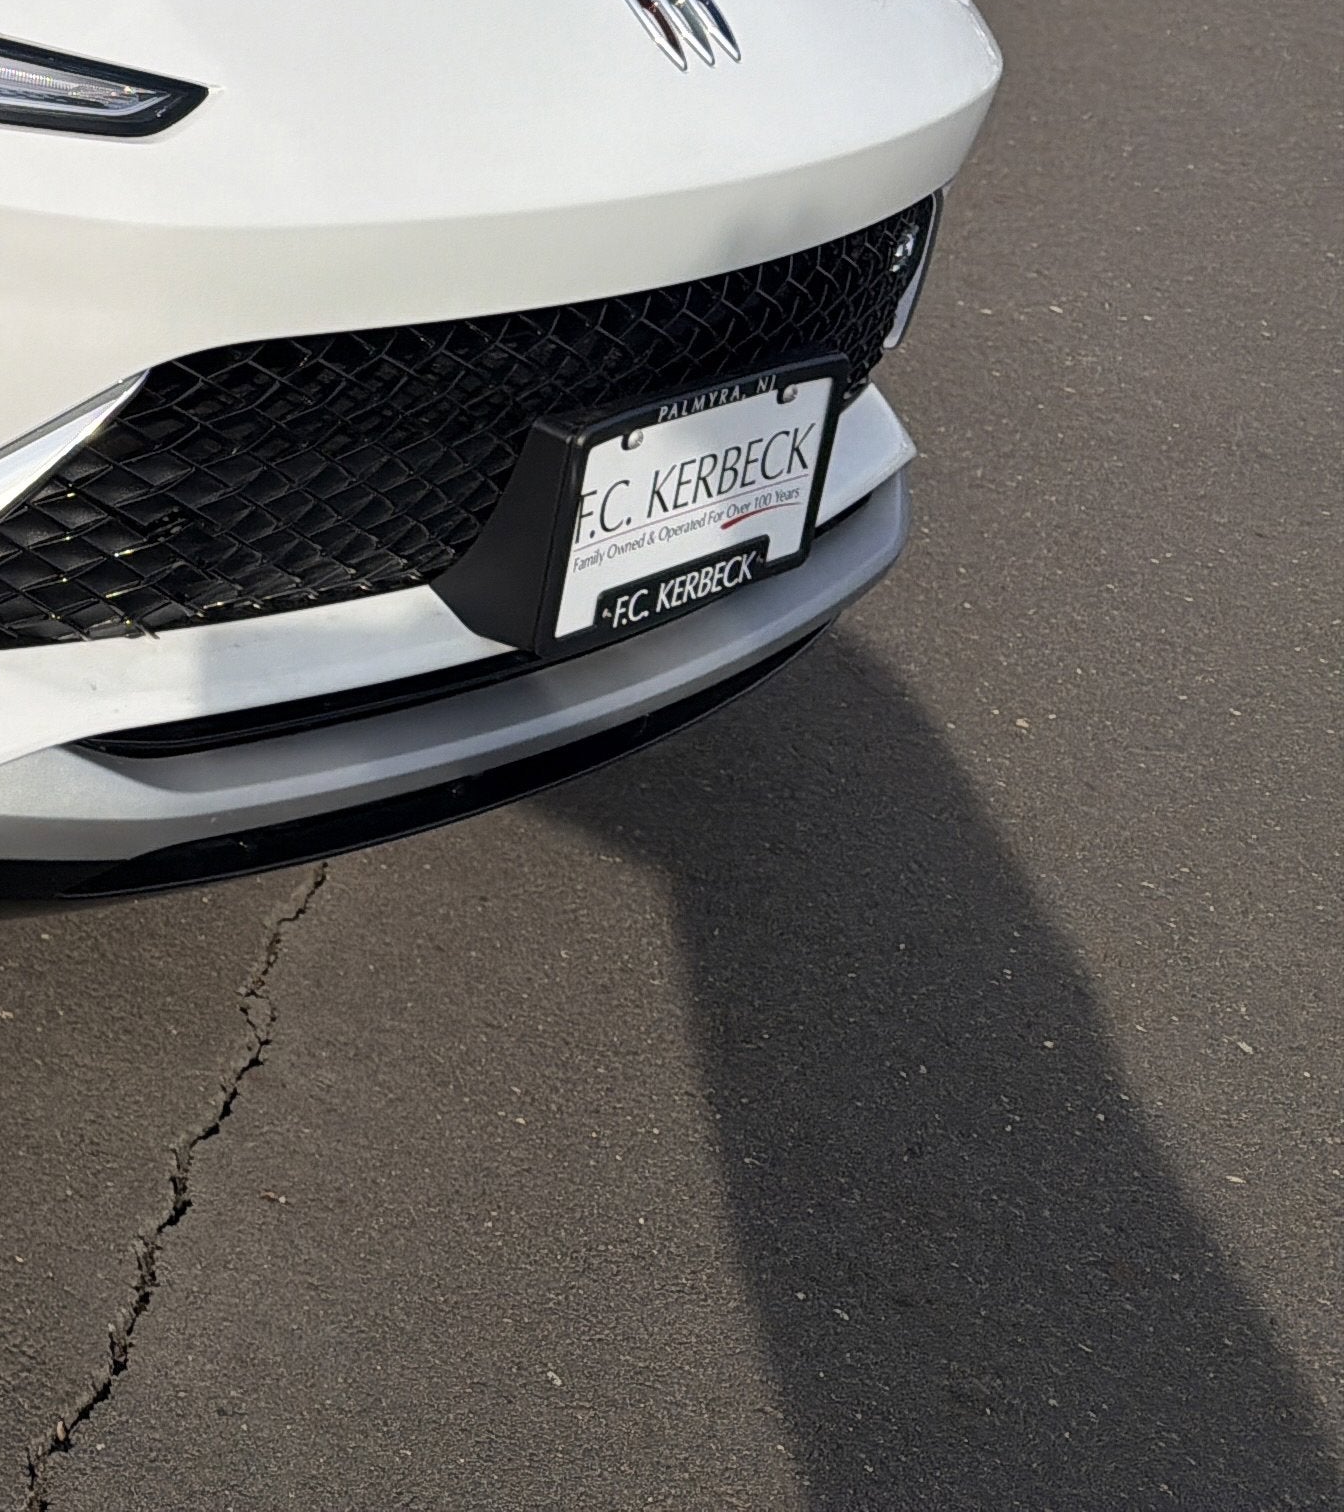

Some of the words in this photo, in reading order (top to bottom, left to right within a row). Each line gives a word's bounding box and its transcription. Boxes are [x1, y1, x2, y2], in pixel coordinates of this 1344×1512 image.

[574, 479, 632, 545] F.C.
[646, 422, 817, 519] KERBECK
[573, 548, 605, 573] Family
[607, 537, 646, 560] Owned
[648, 530, 657, 545] &
[657, 512, 707, 542] Operated
[708, 509, 725, 528] For
[726, 502, 750, 519] Over
[754, 493, 772, 510] 100
[774, 488, 800, 507] Years
[612, 588, 650, 629] F.C.
[655, 552, 758, 613] KERBECK
